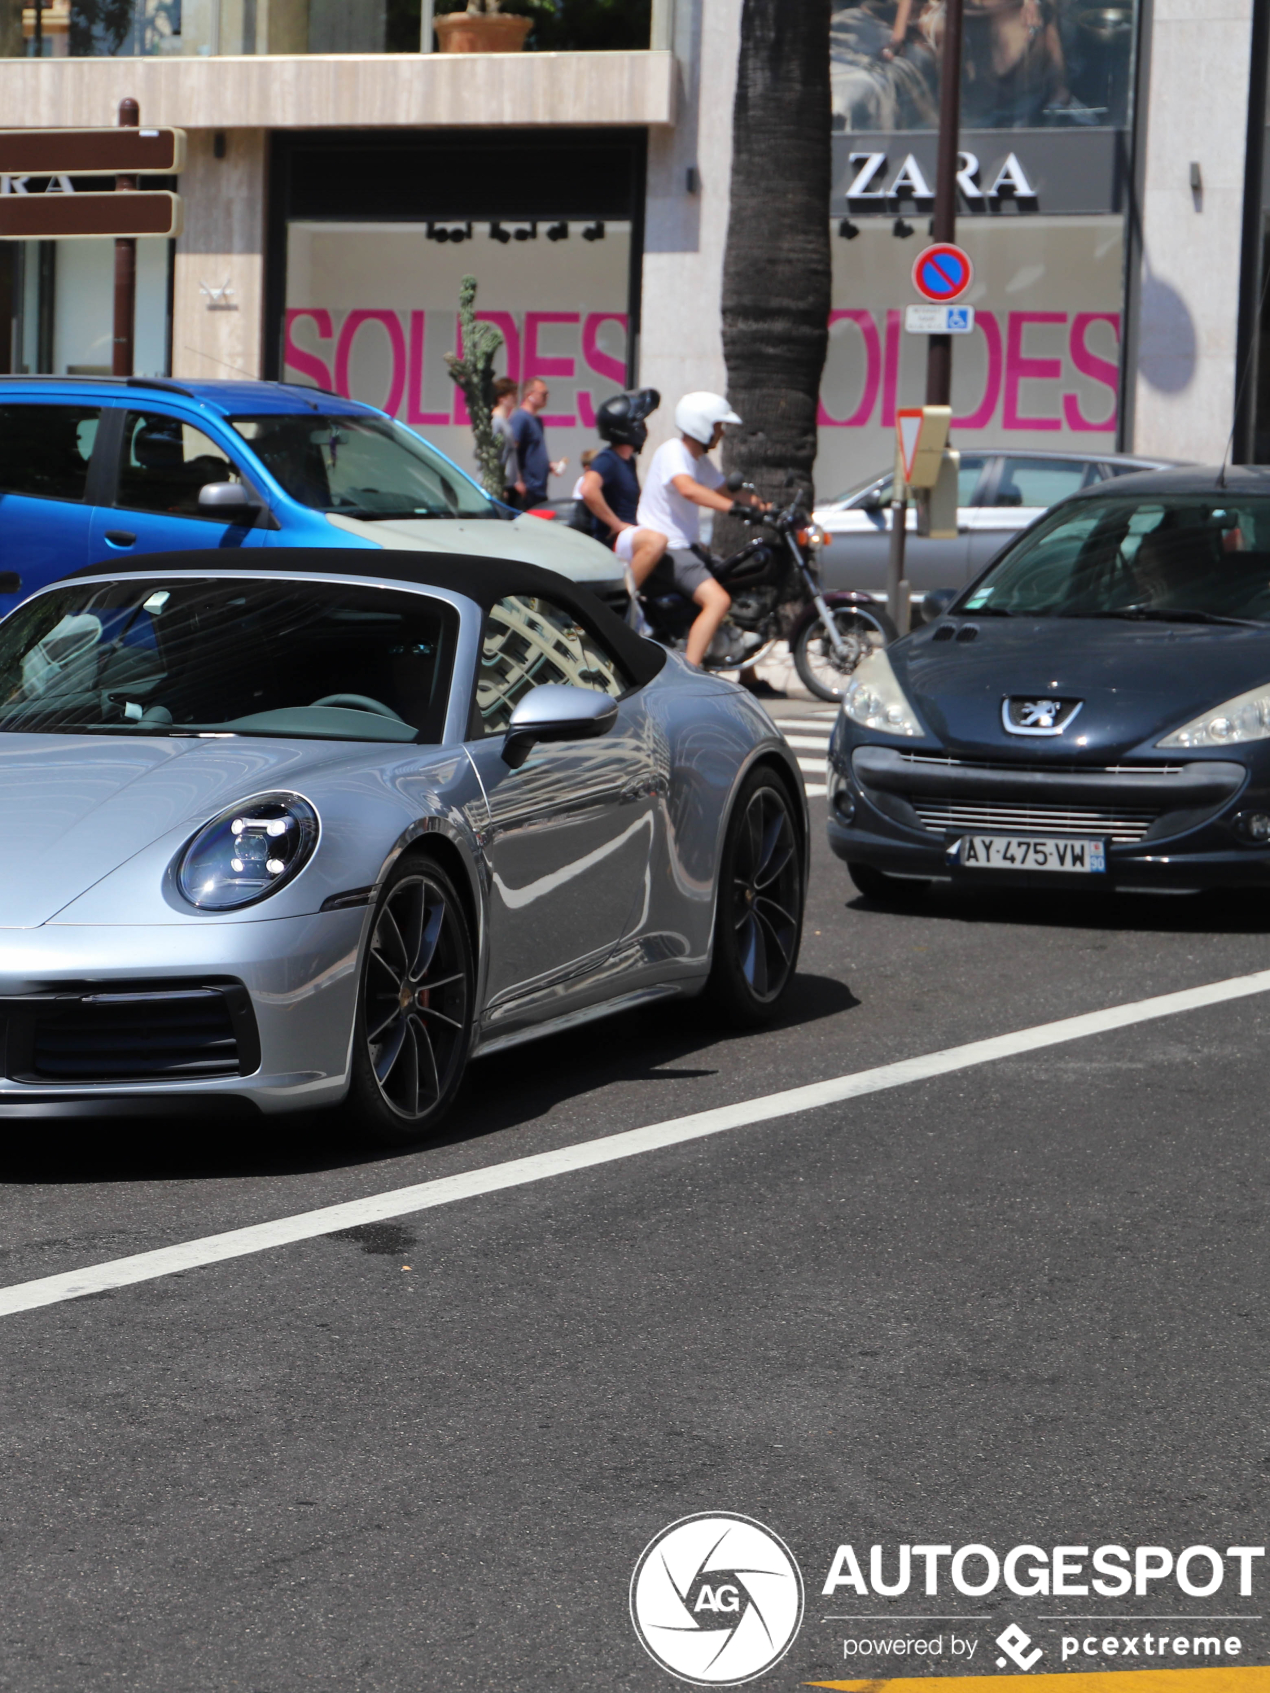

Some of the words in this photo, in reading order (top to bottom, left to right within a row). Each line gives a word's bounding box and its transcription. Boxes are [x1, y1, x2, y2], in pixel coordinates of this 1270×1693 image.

[845, 151, 1037, 198] ZARA
[285, 308, 628, 428] SOLDES
[816, 309, 1121, 431] OLDES
[965, 838, 1085, 868] AY-475-VW
[1090, 857, 1105, 870] 90
